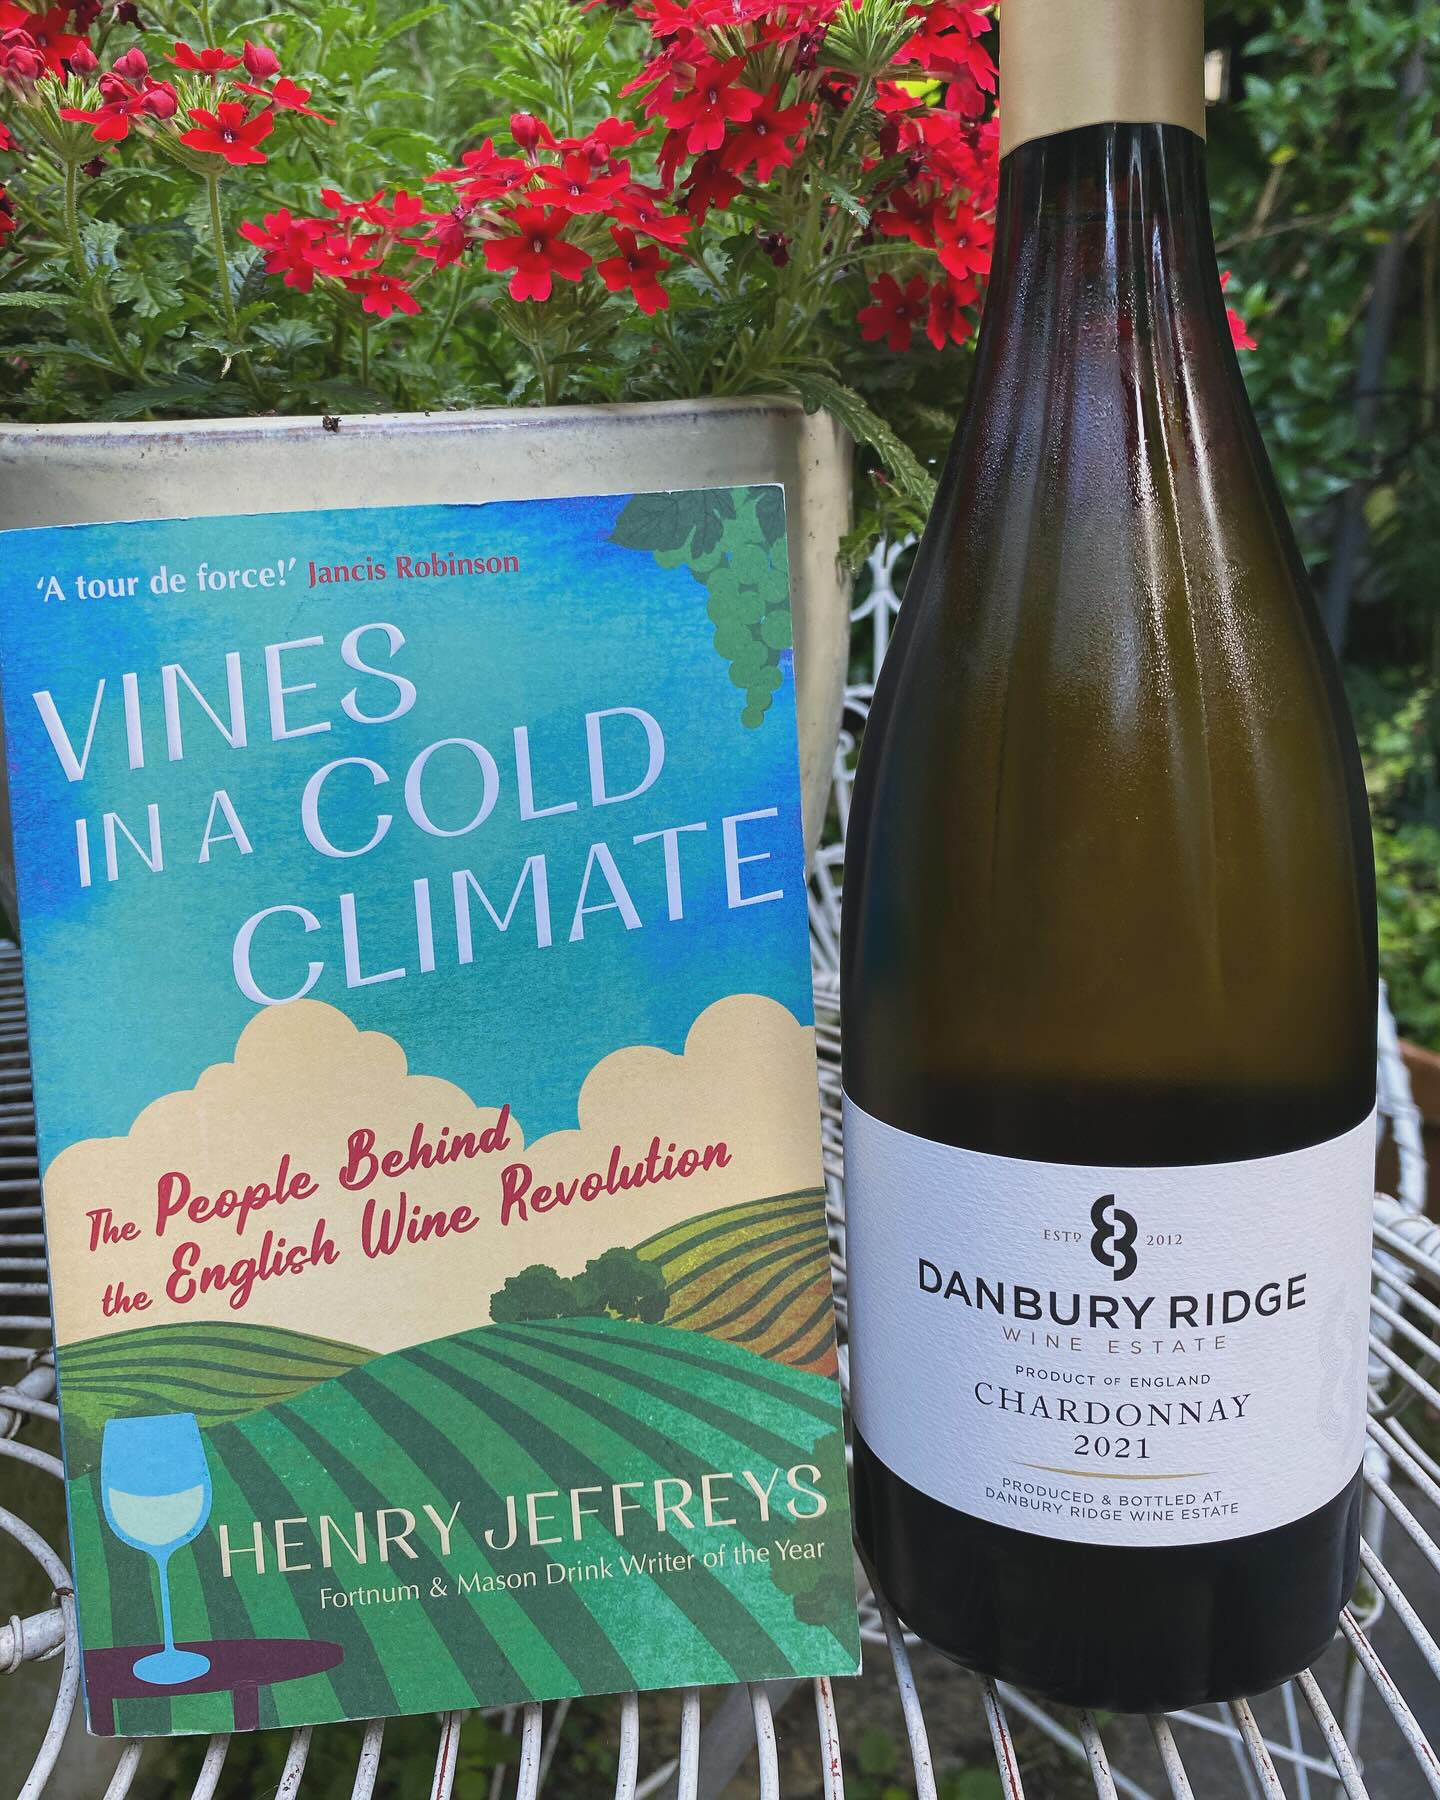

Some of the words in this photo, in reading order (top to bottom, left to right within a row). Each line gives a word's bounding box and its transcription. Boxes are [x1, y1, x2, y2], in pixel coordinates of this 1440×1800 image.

[74, 574, 142, 600] tour
[150, 569, 187, 594] de
[307, 554, 386, 588] Jancis
[396, 552, 519, 582] Robinson
[33, 622, 417, 782] VINES
[75, 803, 163, 887] IN
[199, 790, 254, 863] A
[301, 706, 665, 858] COLD
[232, 807, 784, 1005] CLIMATE
[86, 1207, 141, 1252] The
[155, 1154, 319, 1238] People
[339, 1104, 510, 1191] Behind
[101, 1280, 153, 1317] the
[166, 1219, 339, 1309] English
[362, 1191, 478, 1260] Wine
[501, 1136, 732, 1225] Revolution
[1146, 1234, 1183, 1246] 2012
[919, 1258, 1156, 1330] DANBURY
[1170, 1274, 1307, 1328] RIDGE
[1002, 1326, 1081, 1352] WINE
[1109, 1335, 1227, 1354] ESTATE
[974, 1382, 1251, 1426] CHARDONNAY
[1015, 1365, 1095, 1385] PRODUCT
[1104, 1377, 1120, 1386] OF
[1130, 1374, 1211, 1387] ENGLAND
[1074, 1435, 1151, 1459] 2021
[220, 1502, 462, 1578] HENRY
[484, 1464, 827, 1552] JEFFREYS
[985, 1487, 1063, 1514] DANBURY
[1071, 1506, 1122, 1520] RIDGE
[1130, 1508, 1174, 1521] WINE
[1181, 1504, 1239, 1520] ESTATE
[1002, 1478, 1094, 1504] PRODUCED
[1102, 1494, 1111, 1505] &
[1119, 1492, 1195, 1506] BOTTLED
[1202, 1490, 1222, 1503] AT
[320, 1581, 420, 1610] Fortnum
[429, 1577, 448, 1598] &
[457, 1565, 538, 1595] Mason
[546, 1555, 614, 1586] Drink
[621, 1549, 696, 1577] Writer
[702, 1545, 727, 1567] of
[733, 1542, 769, 1566] the
[776, 1538, 825, 1563] Year
